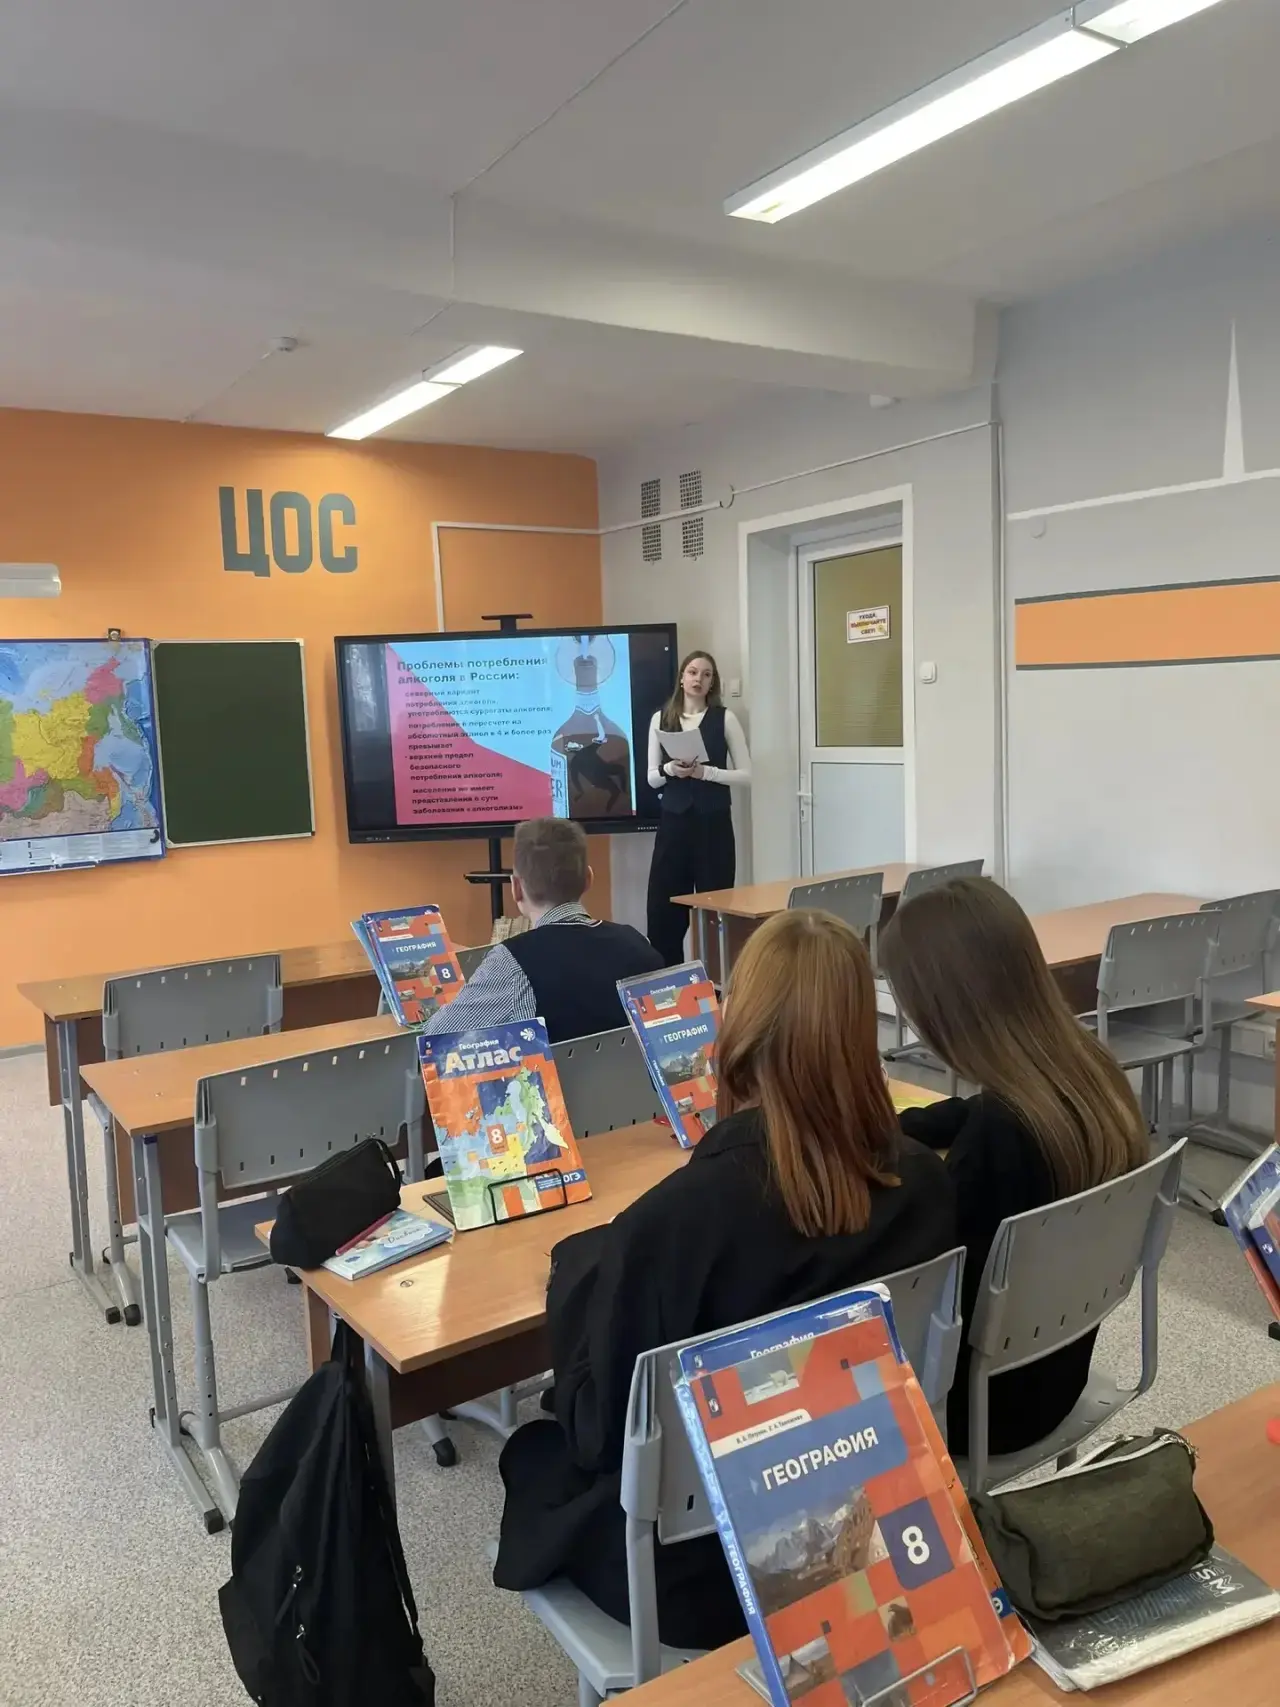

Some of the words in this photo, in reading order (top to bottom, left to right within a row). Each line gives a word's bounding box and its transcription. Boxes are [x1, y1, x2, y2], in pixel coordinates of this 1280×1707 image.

[219, 486, 358, 578] ЦОС
[397, 660, 463, 672] Проблемы
[467, 657, 548, 669] потребления
[398, 674, 456, 685] алкоголя
[470, 671, 520, 681] России:
[395, 941, 437, 953] ГЕОГРАФИЯ
[441, 967, 452, 979] 8
[663, 1024, 709, 1044] ГЕОГРАФИЯ
[459, 1038, 500, 1051] География
[444, 1046, 523, 1075] Атлас
[490, 1128, 504, 1144] 8
[562, 1171, 581, 1184] ОГЭ
[762, 1426, 879, 1490] ГЕОГРАФИЯ
[901, 1525, 930, 1565] 8
[727, 1543, 756, 1615] ГЕОГРАФИЯ
